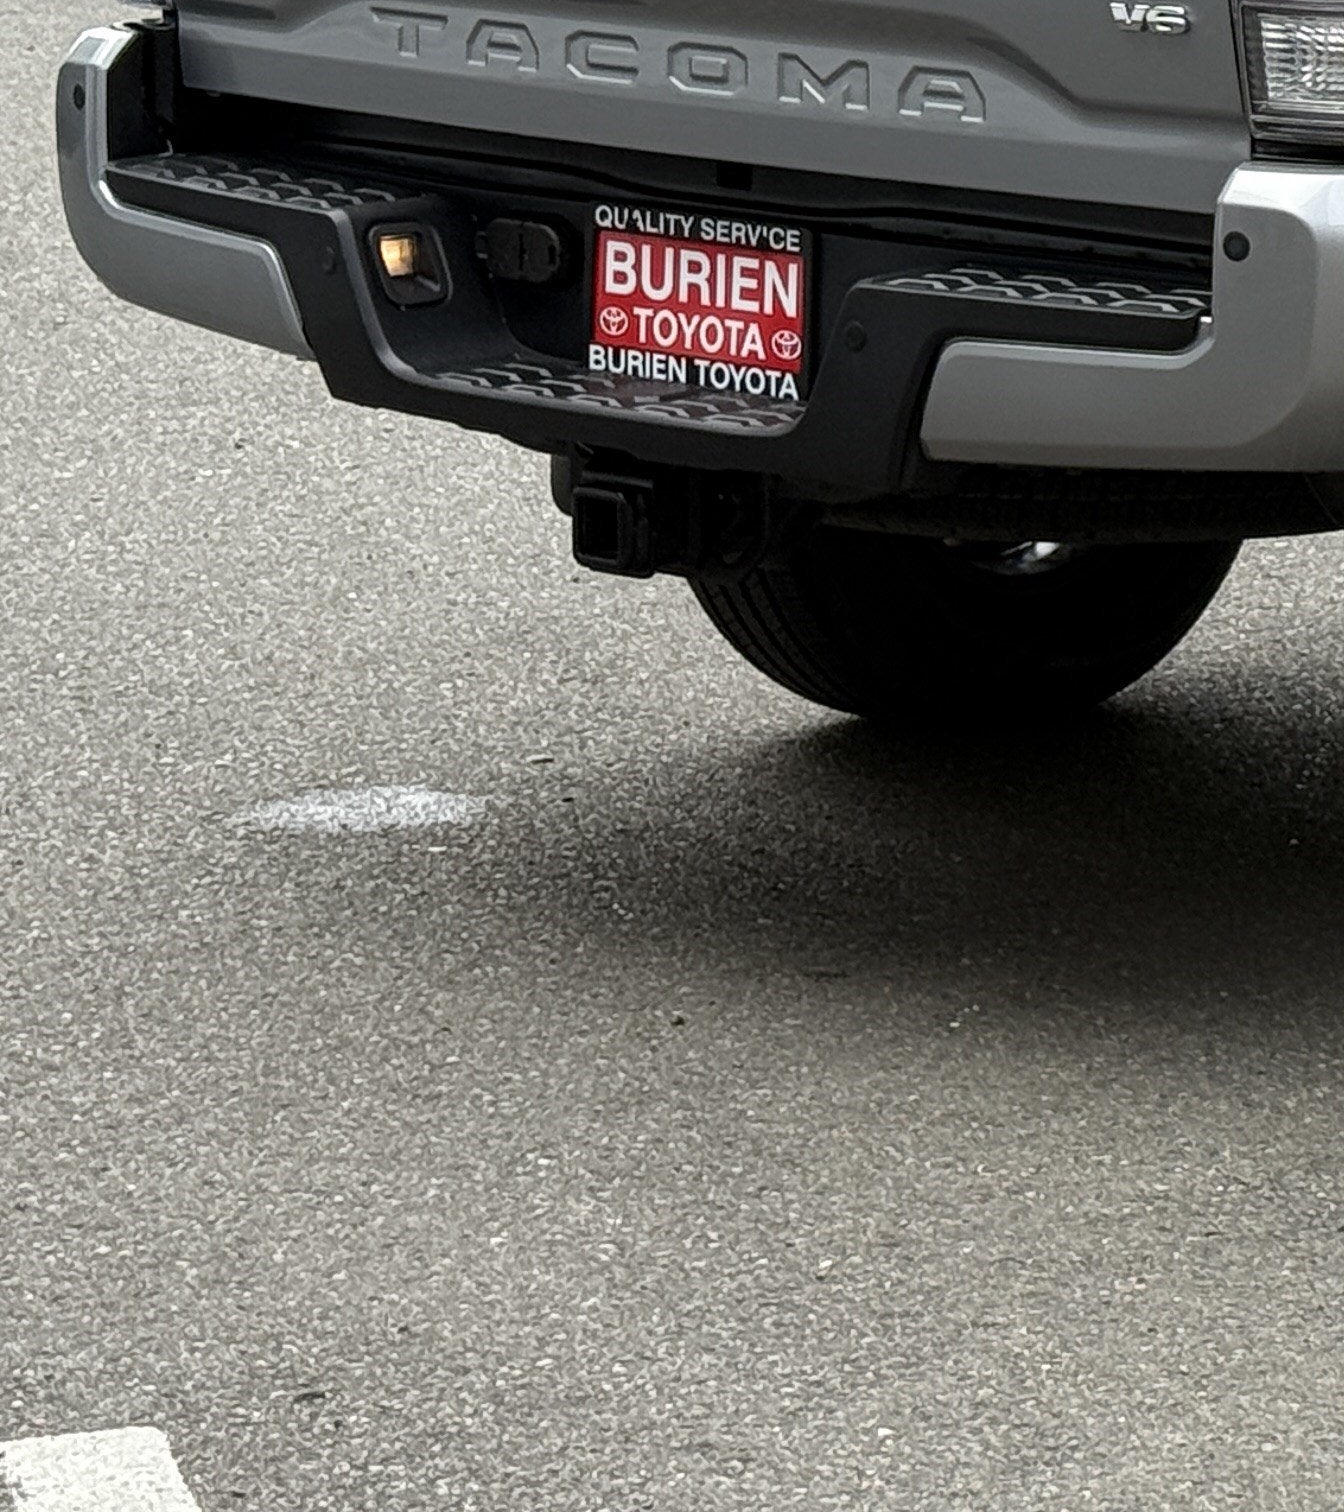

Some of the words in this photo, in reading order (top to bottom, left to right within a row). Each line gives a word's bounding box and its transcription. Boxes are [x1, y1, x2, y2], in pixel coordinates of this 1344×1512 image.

[1109, 1, 1188, 33] V6
[369, 5, 987, 123] TACOMA
[605, 240, 799, 318] BURIEN
[632, 306, 767, 361] TOYOTA
[589, 344, 687, 384] BURIEN
[693, 359, 800, 402] TOYOTA
